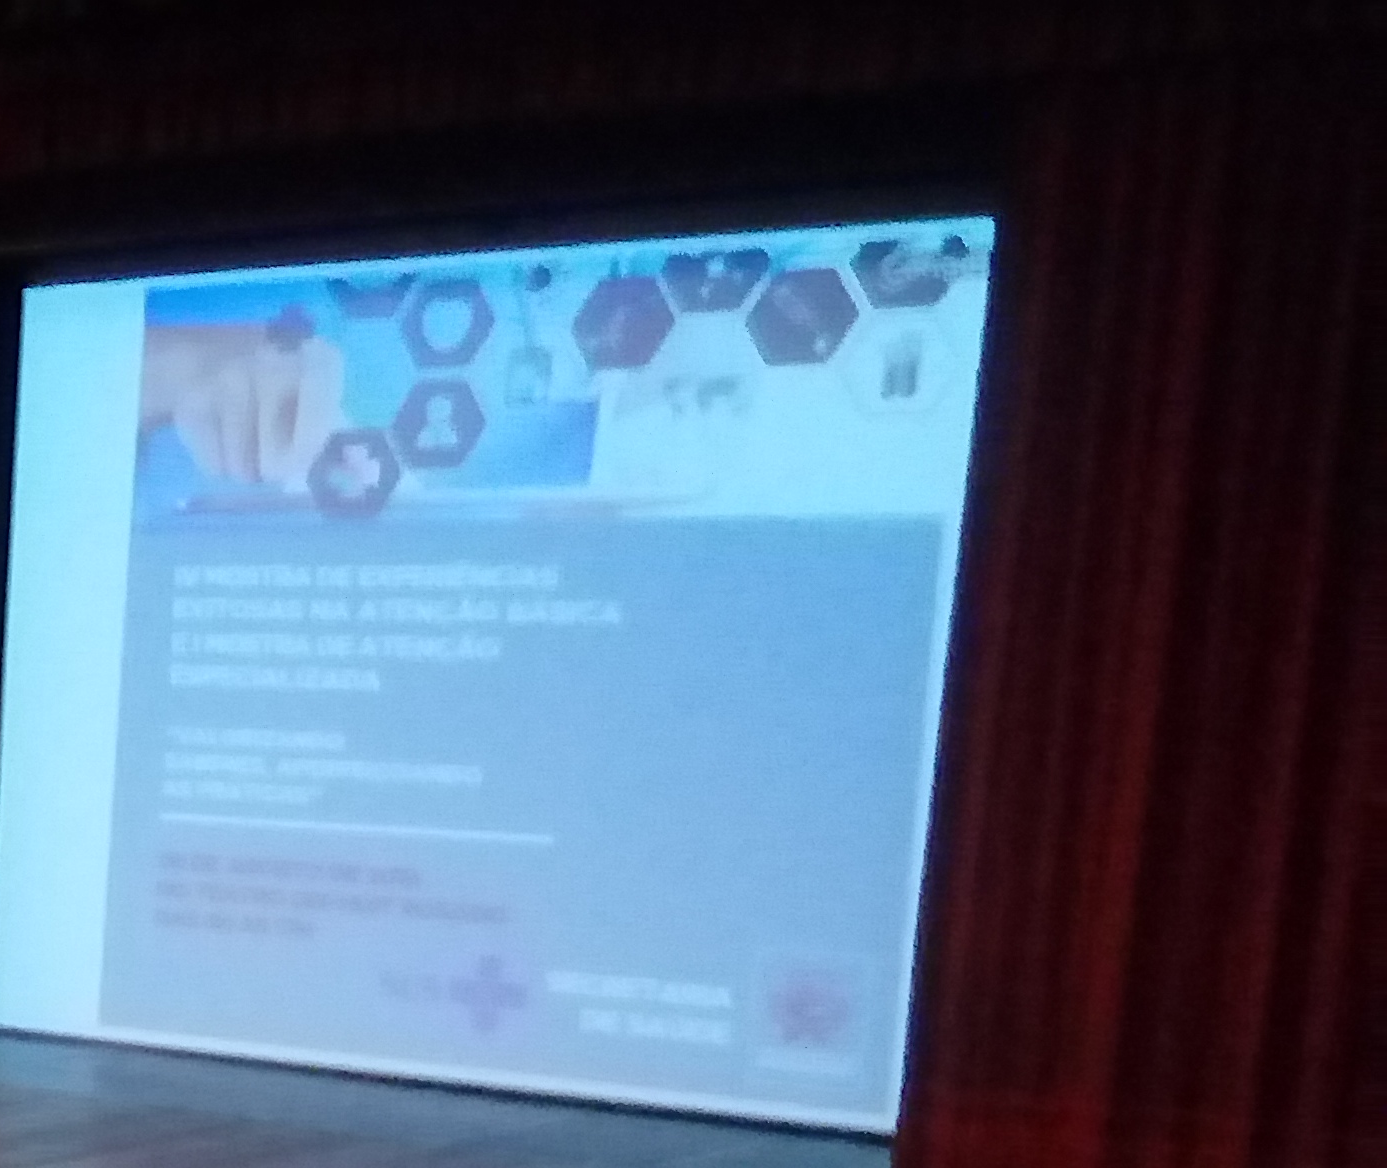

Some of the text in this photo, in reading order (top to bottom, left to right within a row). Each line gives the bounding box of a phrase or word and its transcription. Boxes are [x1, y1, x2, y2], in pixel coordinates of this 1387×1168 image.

[205, 565, 311, 587] MOSTRA
[316, 567, 352, 588] DE
[310, 599, 349, 621] NA
[358, 597, 500, 625] ATENÇÃO
[506, 598, 624, 625] BÁSICA
[204, 633, 311, 657] MOSTRA
[316, 635, 354, 659] DE
[357, 634, 503, 663] ATENÇÃO
[170, 663, 382, 691] ESPECIALIZADA
